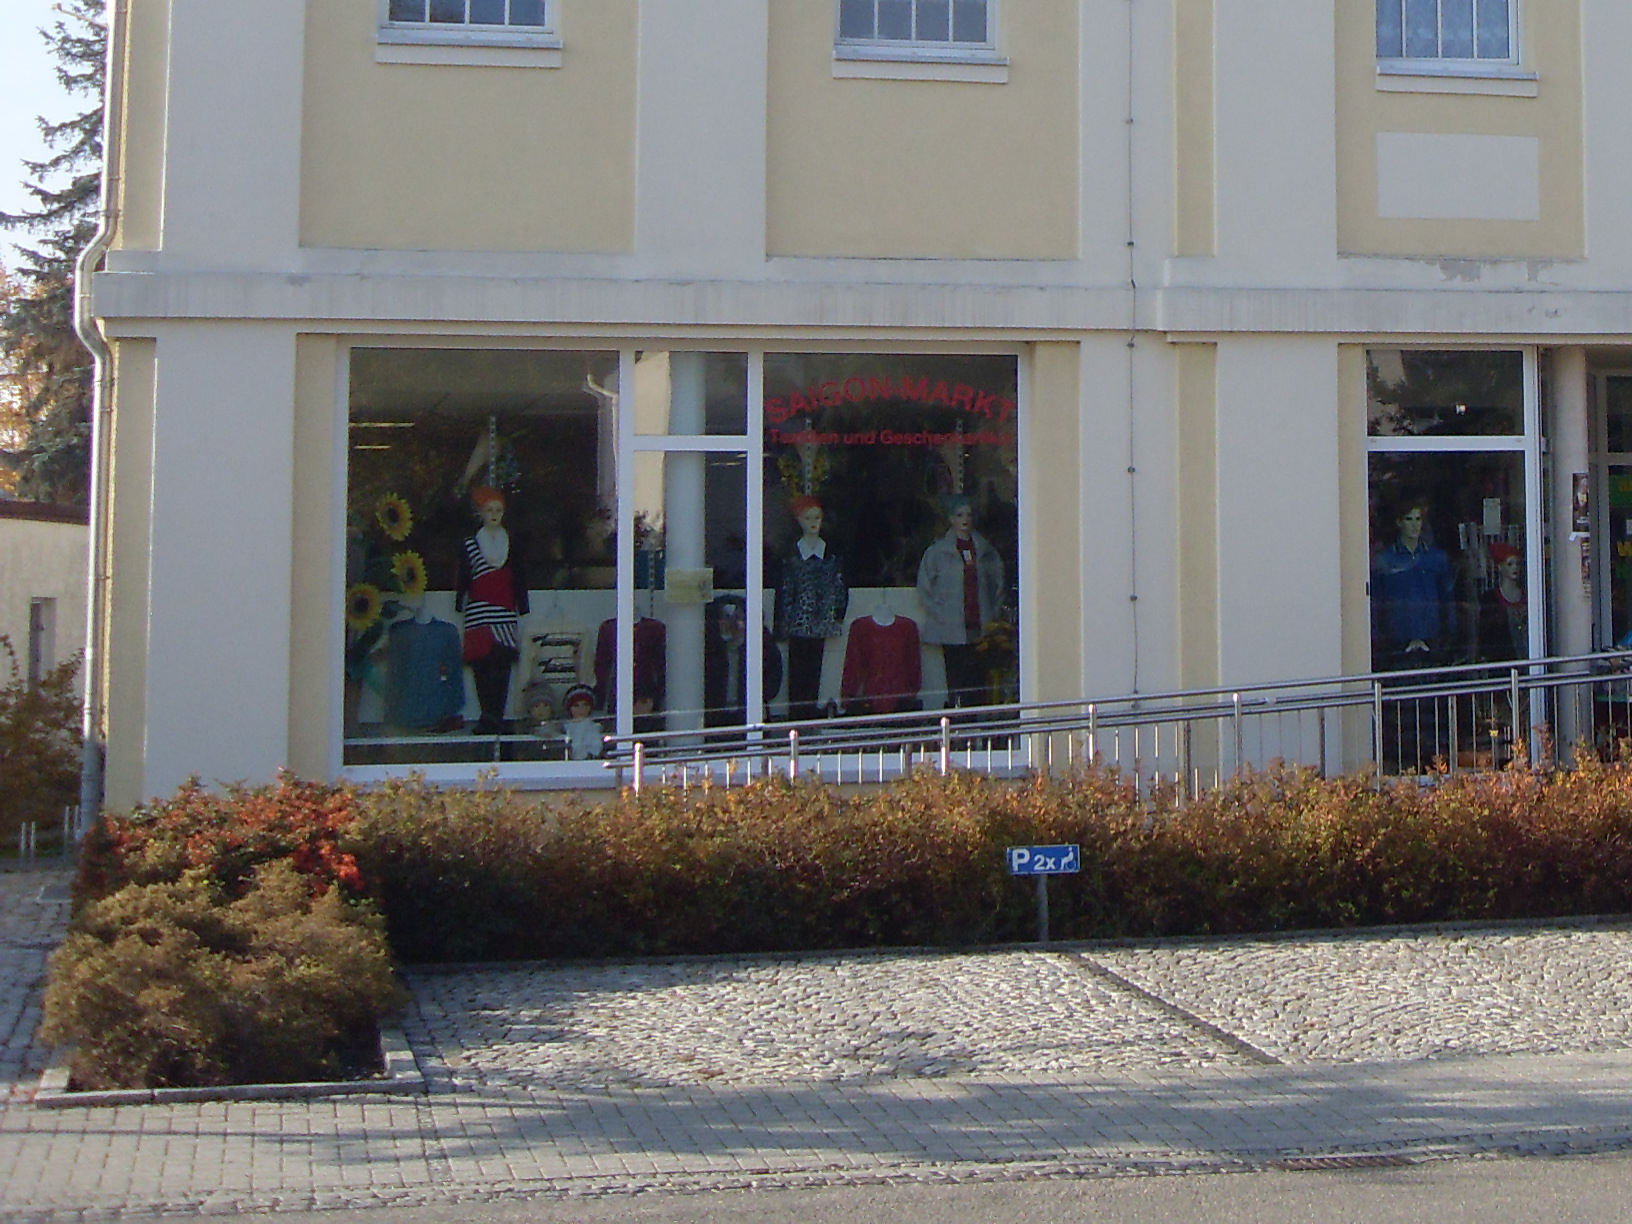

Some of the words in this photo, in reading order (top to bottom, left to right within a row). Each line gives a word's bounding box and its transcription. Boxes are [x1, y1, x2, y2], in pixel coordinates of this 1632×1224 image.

[766, 376, 1015, 423] SAIGON-MARKT
[844, 429, 876, 445] und
[1012, 848, 1030, 871] P
[1034, 854, 1056, 870] 2x
